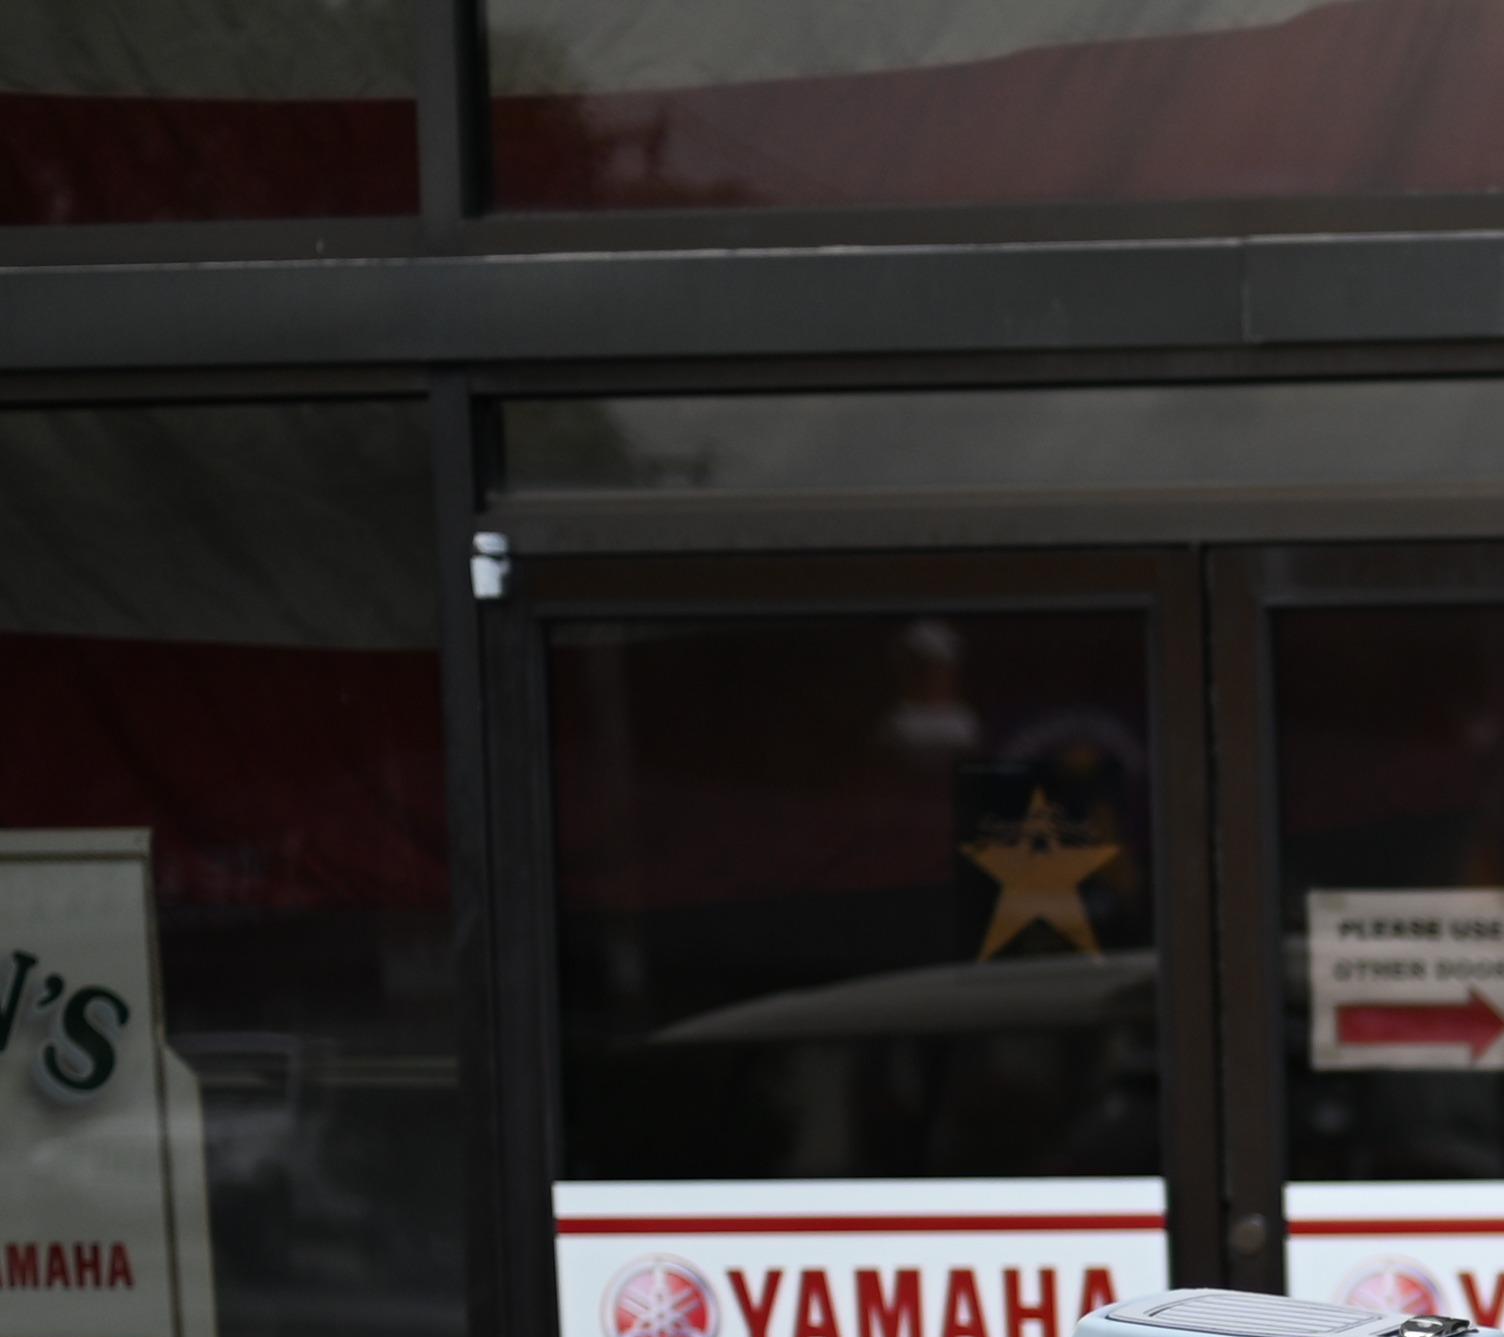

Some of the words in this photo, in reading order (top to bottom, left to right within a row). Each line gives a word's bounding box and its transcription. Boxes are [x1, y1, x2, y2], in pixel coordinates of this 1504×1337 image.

[1338, 919, 1441, 940] PLEASE
[1449, 919, 1504, 940] USE
[0, 1242, 134, 1290] MAHA
